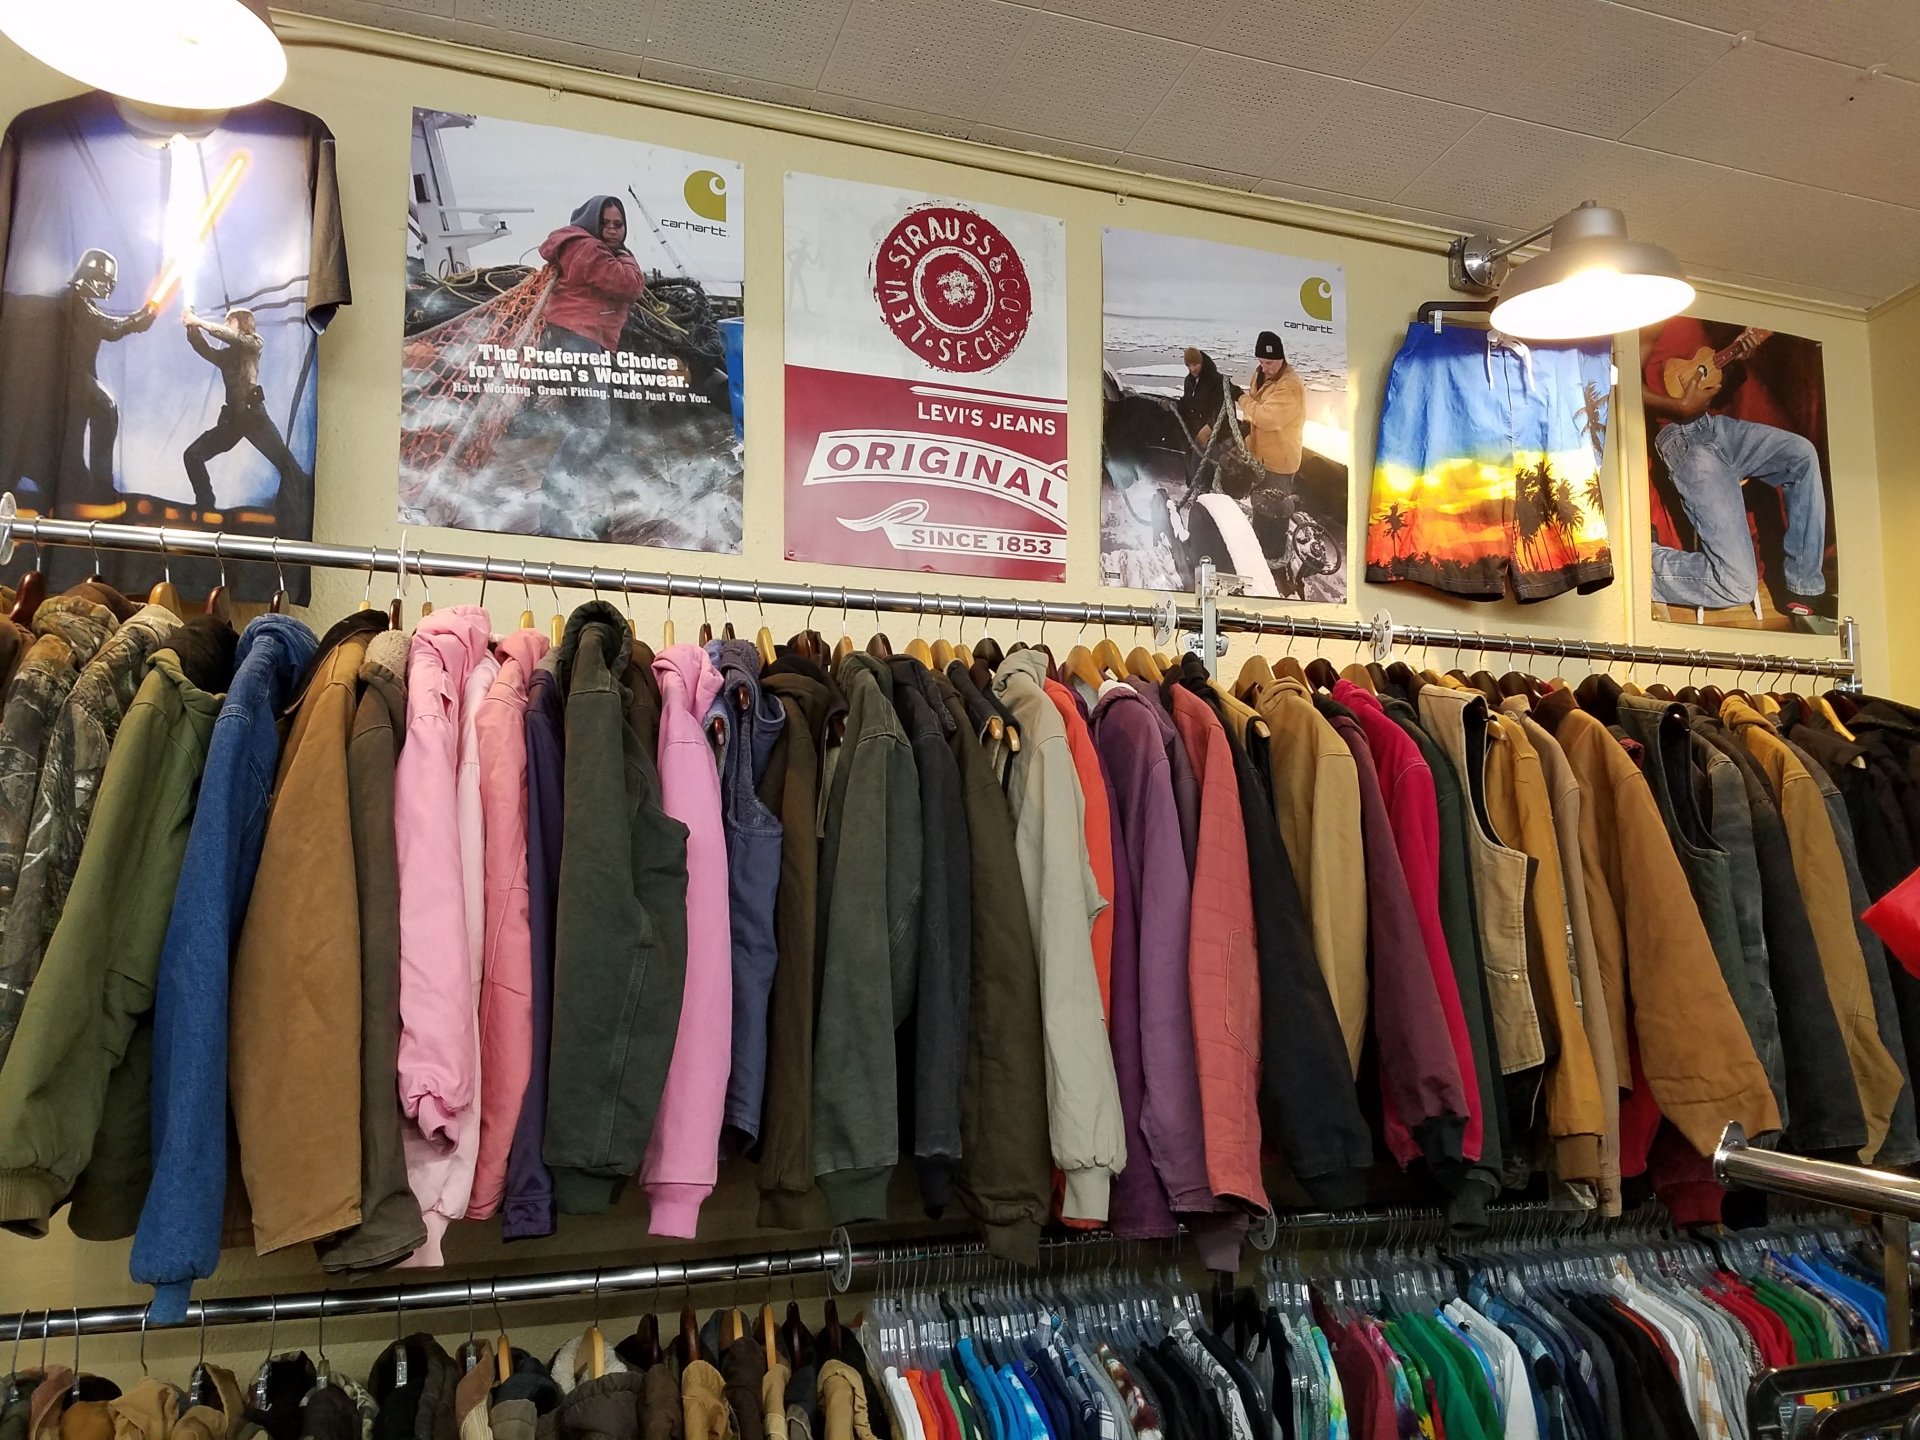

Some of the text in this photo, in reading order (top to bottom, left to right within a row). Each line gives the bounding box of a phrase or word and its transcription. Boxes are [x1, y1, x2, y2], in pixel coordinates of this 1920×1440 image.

[661, 219, 727, 237] carhartt
[888, 216, 995, 269] STRAUSS
[478, 344, 679, 371] The Preferred Choice
[469, 362, 691, 389] for Women's Workwear.
[452, 382, 712, 405] Hard Working. Great Fitting. Made Just For You.
[917, 401, 1056, 436] LEVI'S JEANS
[826, 441, 1059, 509] ORIGINAL
[911, 529, 1051, 556] SINCE 1853
